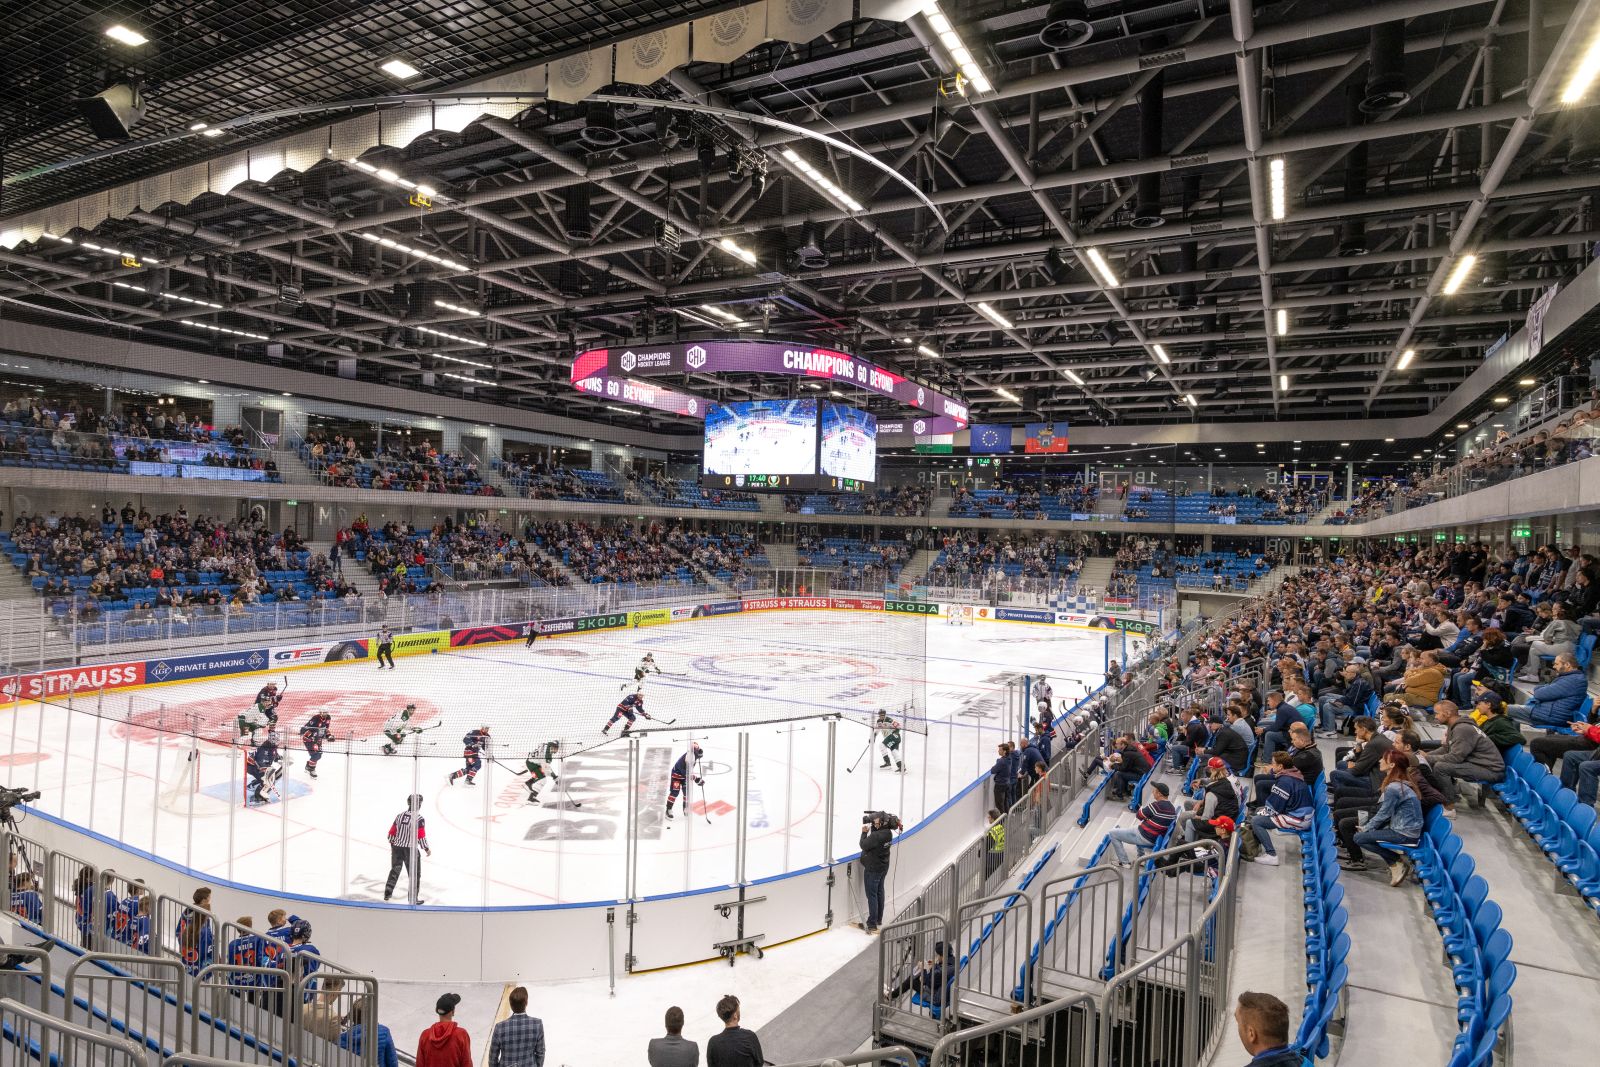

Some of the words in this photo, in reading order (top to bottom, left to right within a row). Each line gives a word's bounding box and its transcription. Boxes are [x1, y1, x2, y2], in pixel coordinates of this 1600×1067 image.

[638, 352, 671, 361] CHAMPIONS
[687, 346, 706, 368] CHL
[783, 350, 854, 379] CHAMPIONS
[857, 365, 867, 382] GO
[870, 369, 894, 393] BEYOND
[607, 380, 619, 397] GO
[623, 384, 655, 404] BEYOND
[725, 476, 731, 485] 0
[785, 476, 790, 485] 1
[750, 600, 778, 609] STRAUSS
[788, 599, 827, 608] STRAUSS
[174, 663, 207, 673] PRIVATE
[209, 659, 245, 669] BANKING
[29, 666, 137, 695] STRAUSS
